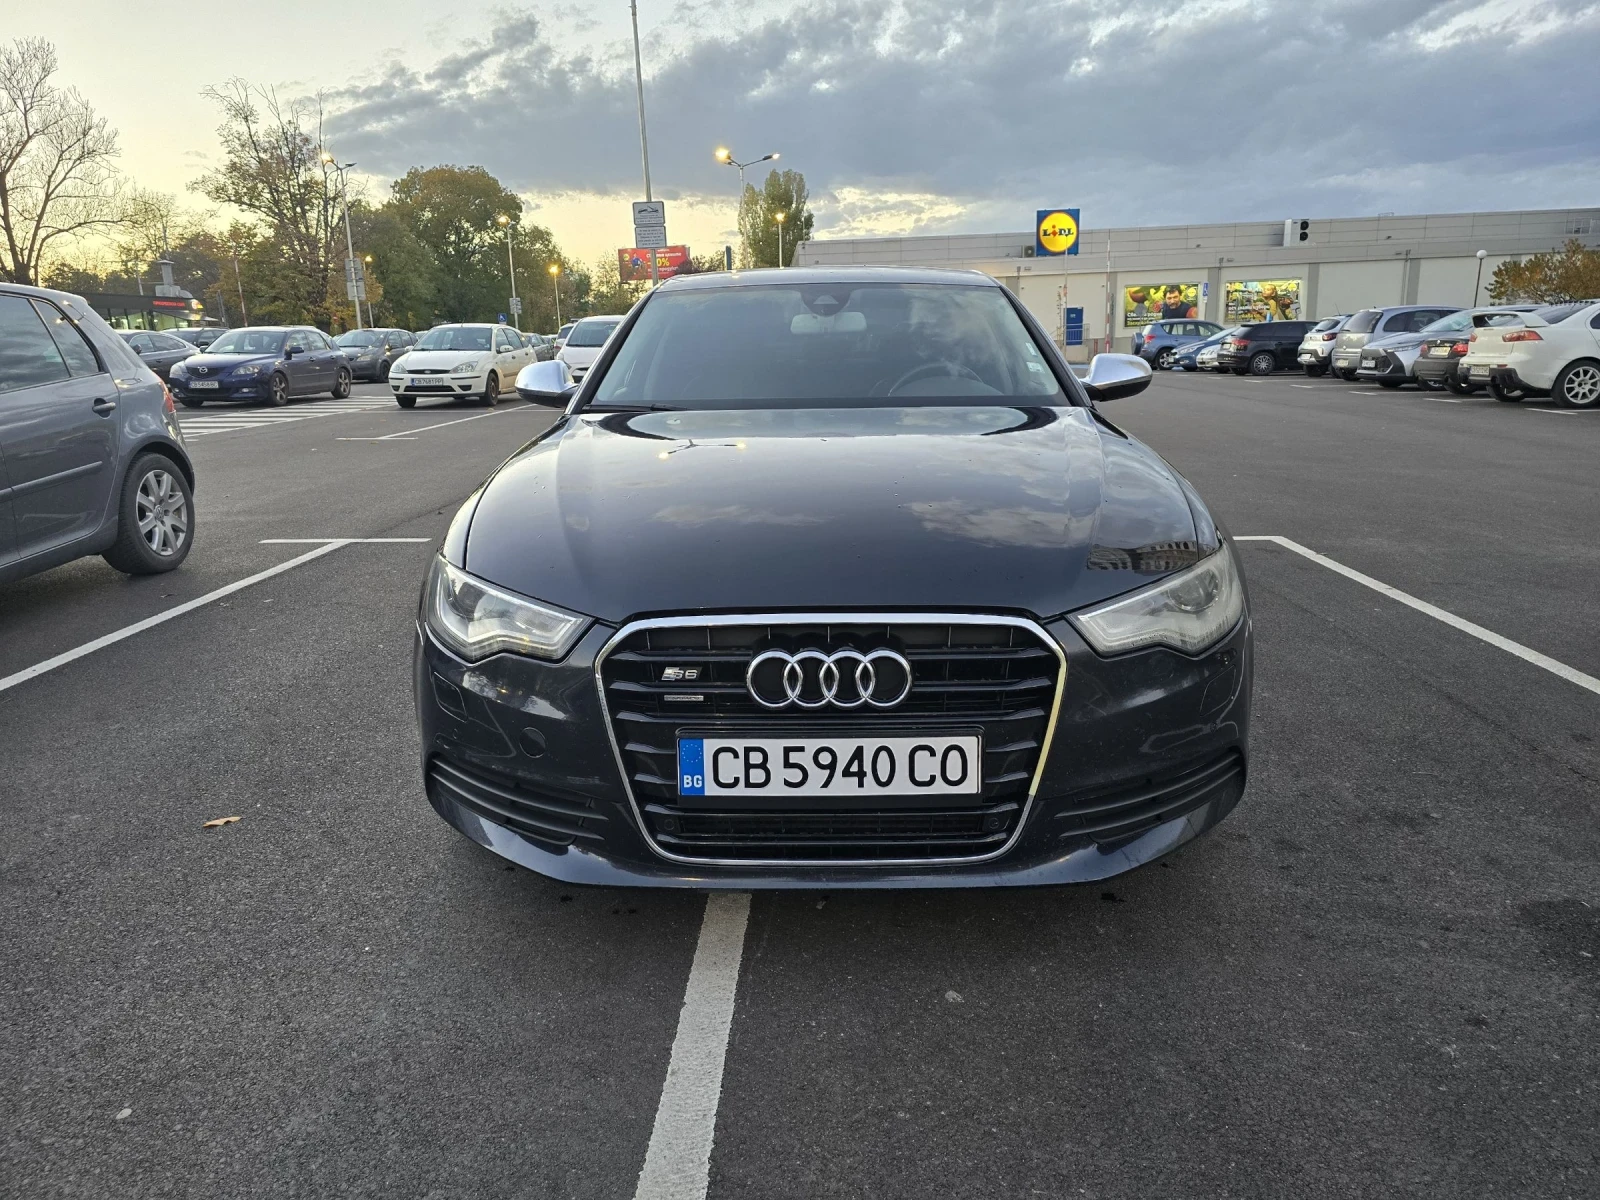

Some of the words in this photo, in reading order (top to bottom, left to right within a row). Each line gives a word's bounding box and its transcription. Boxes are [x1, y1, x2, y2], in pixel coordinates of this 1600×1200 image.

[683, 774, 703, 789] BG
[712, 746, 772, 789] CB
[783, 745, 897, 788] 5940
